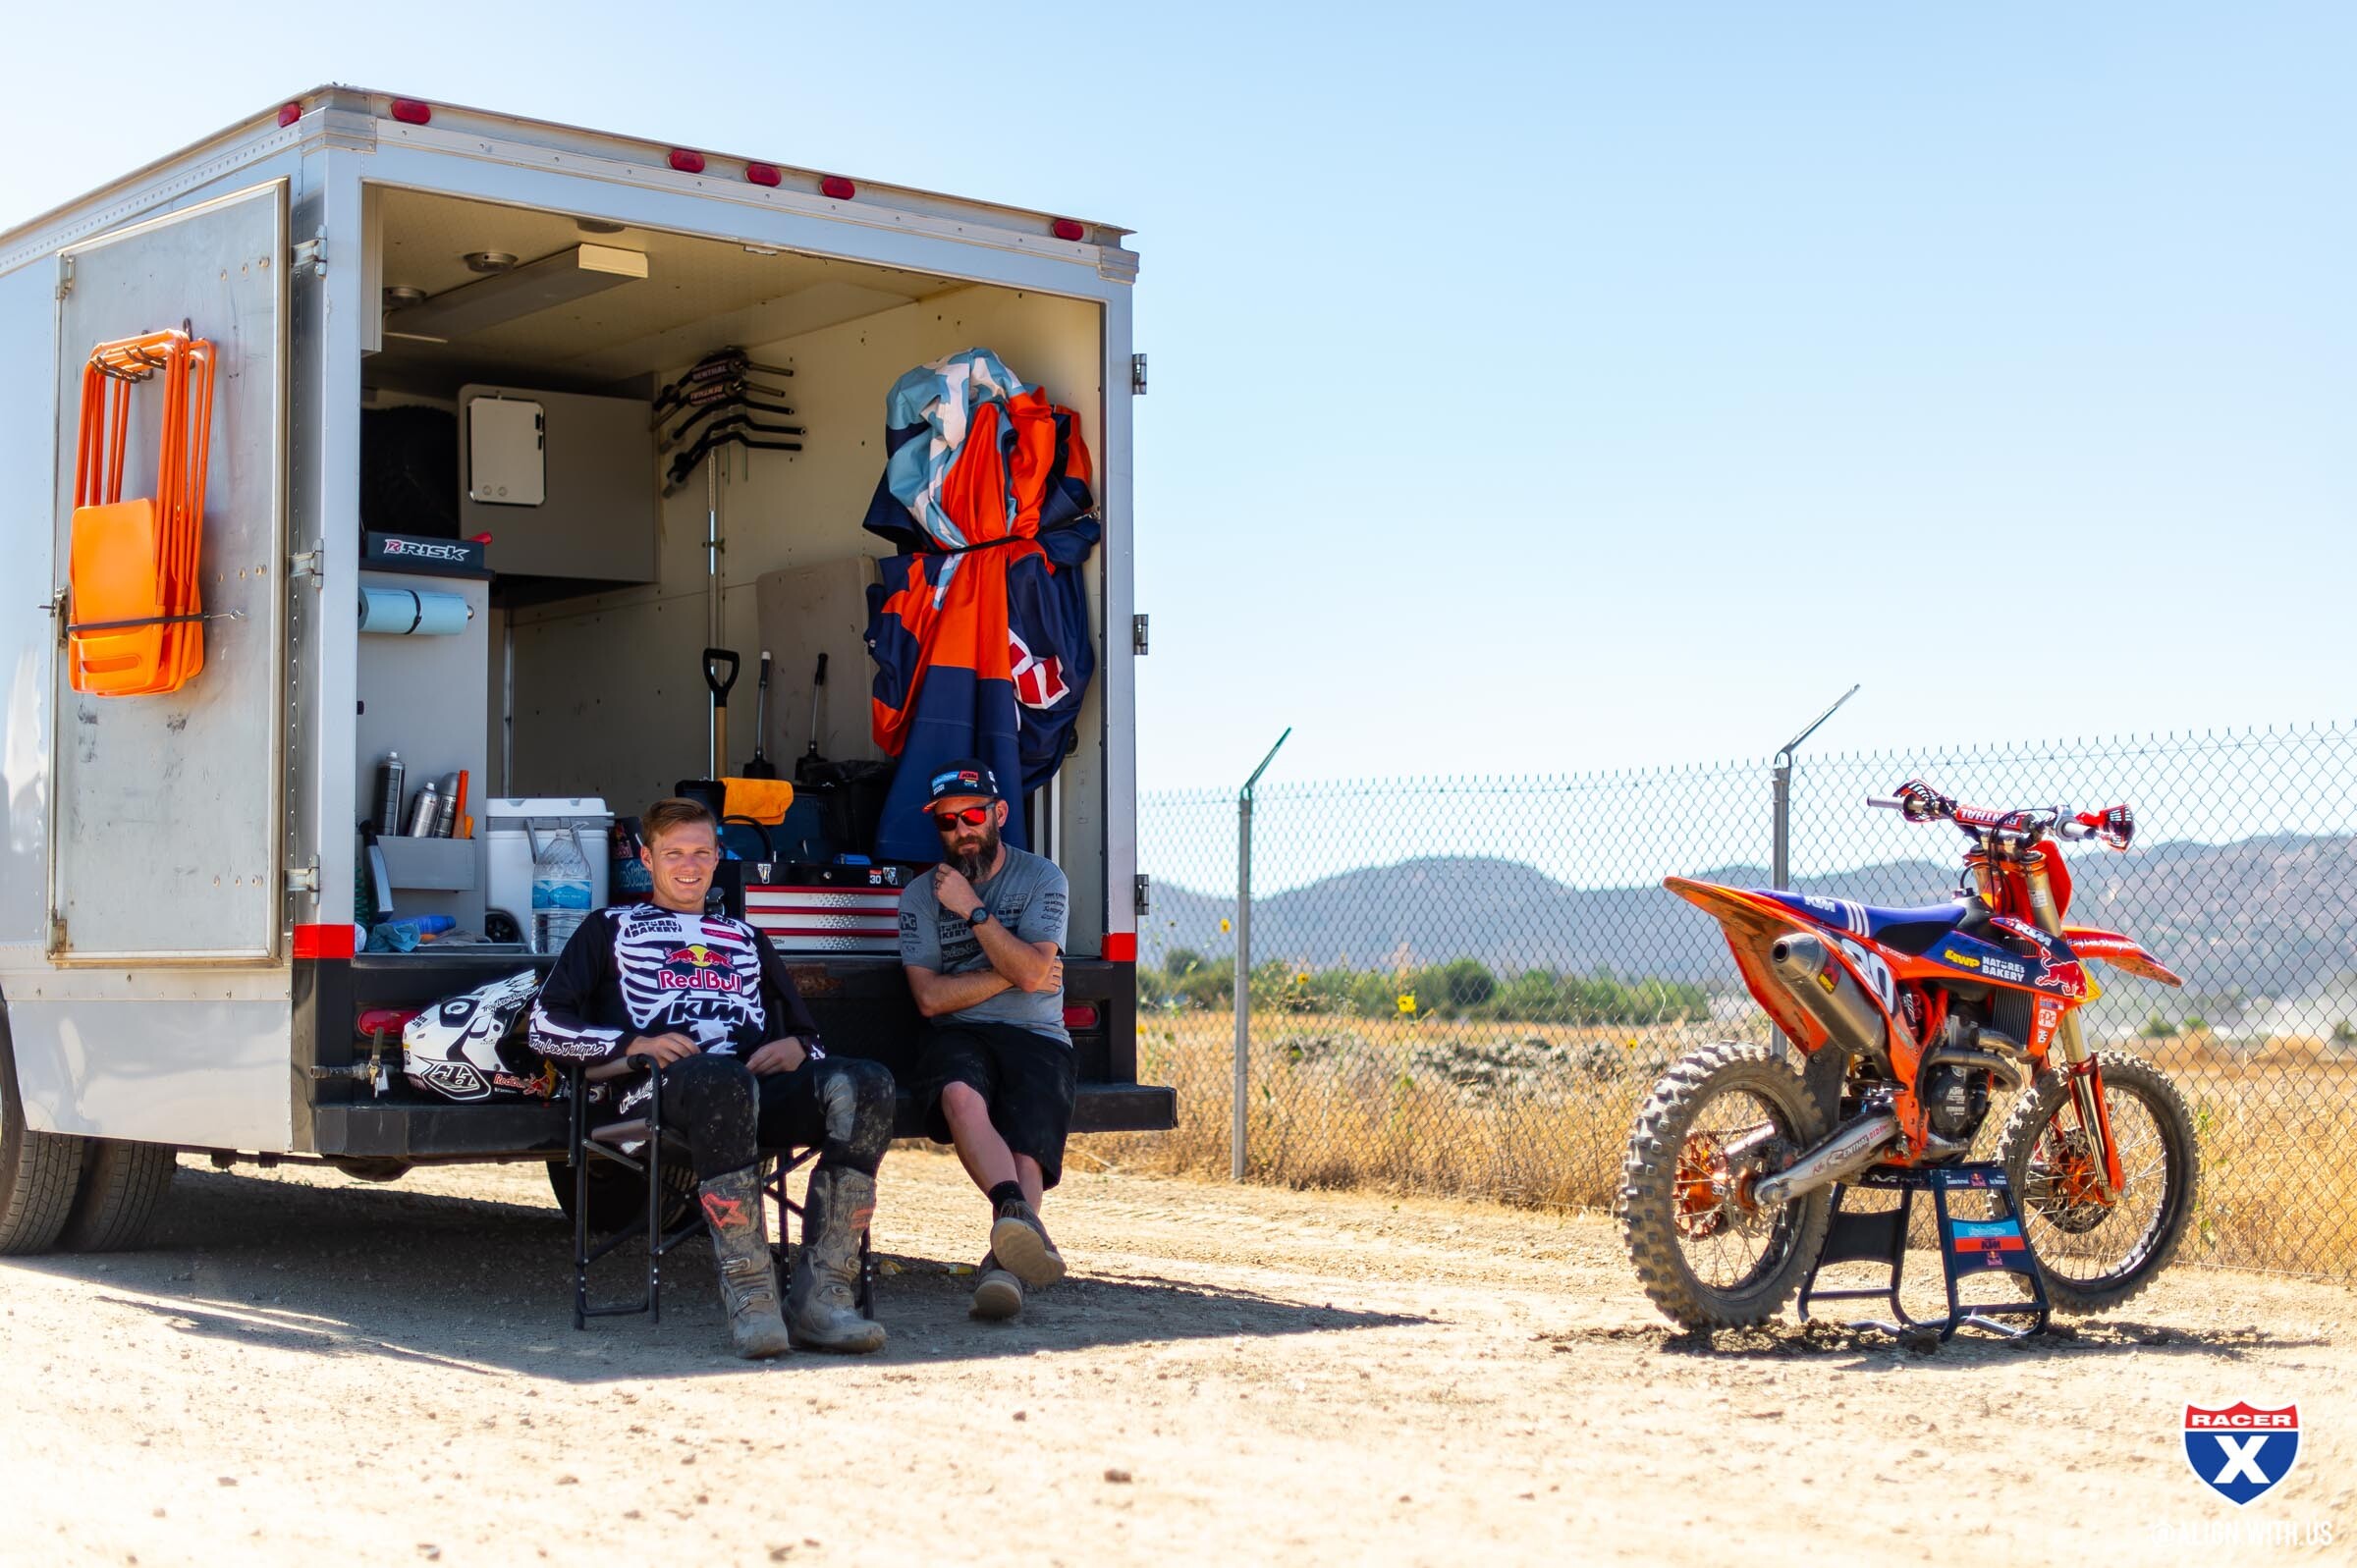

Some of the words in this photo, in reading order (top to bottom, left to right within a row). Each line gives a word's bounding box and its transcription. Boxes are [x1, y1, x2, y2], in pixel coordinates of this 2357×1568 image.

[401, 541, 469, 562] RISK
[1960, 808, 2020, 826] RNTHAL
[869, 875, 882, 885] 30
[1803, 895, 1836, 912] KTM
[631, 926, 678, 938] BAKERY
[2014, 923, 2052, 946] KTM
[658, 968, 703, 990] Red
[704, 969, 742, 994] Bull
[1982, 965, 2025, 983] BAKERY
[667, 996, 745, 1026] KTM
[529, 1034, 545, 1055] Troy
[544, 1038, 562, 1054] Lee
[561, 1041, 604, 1061] Designs
[1981, 1238, 2001, 1250] KTM
